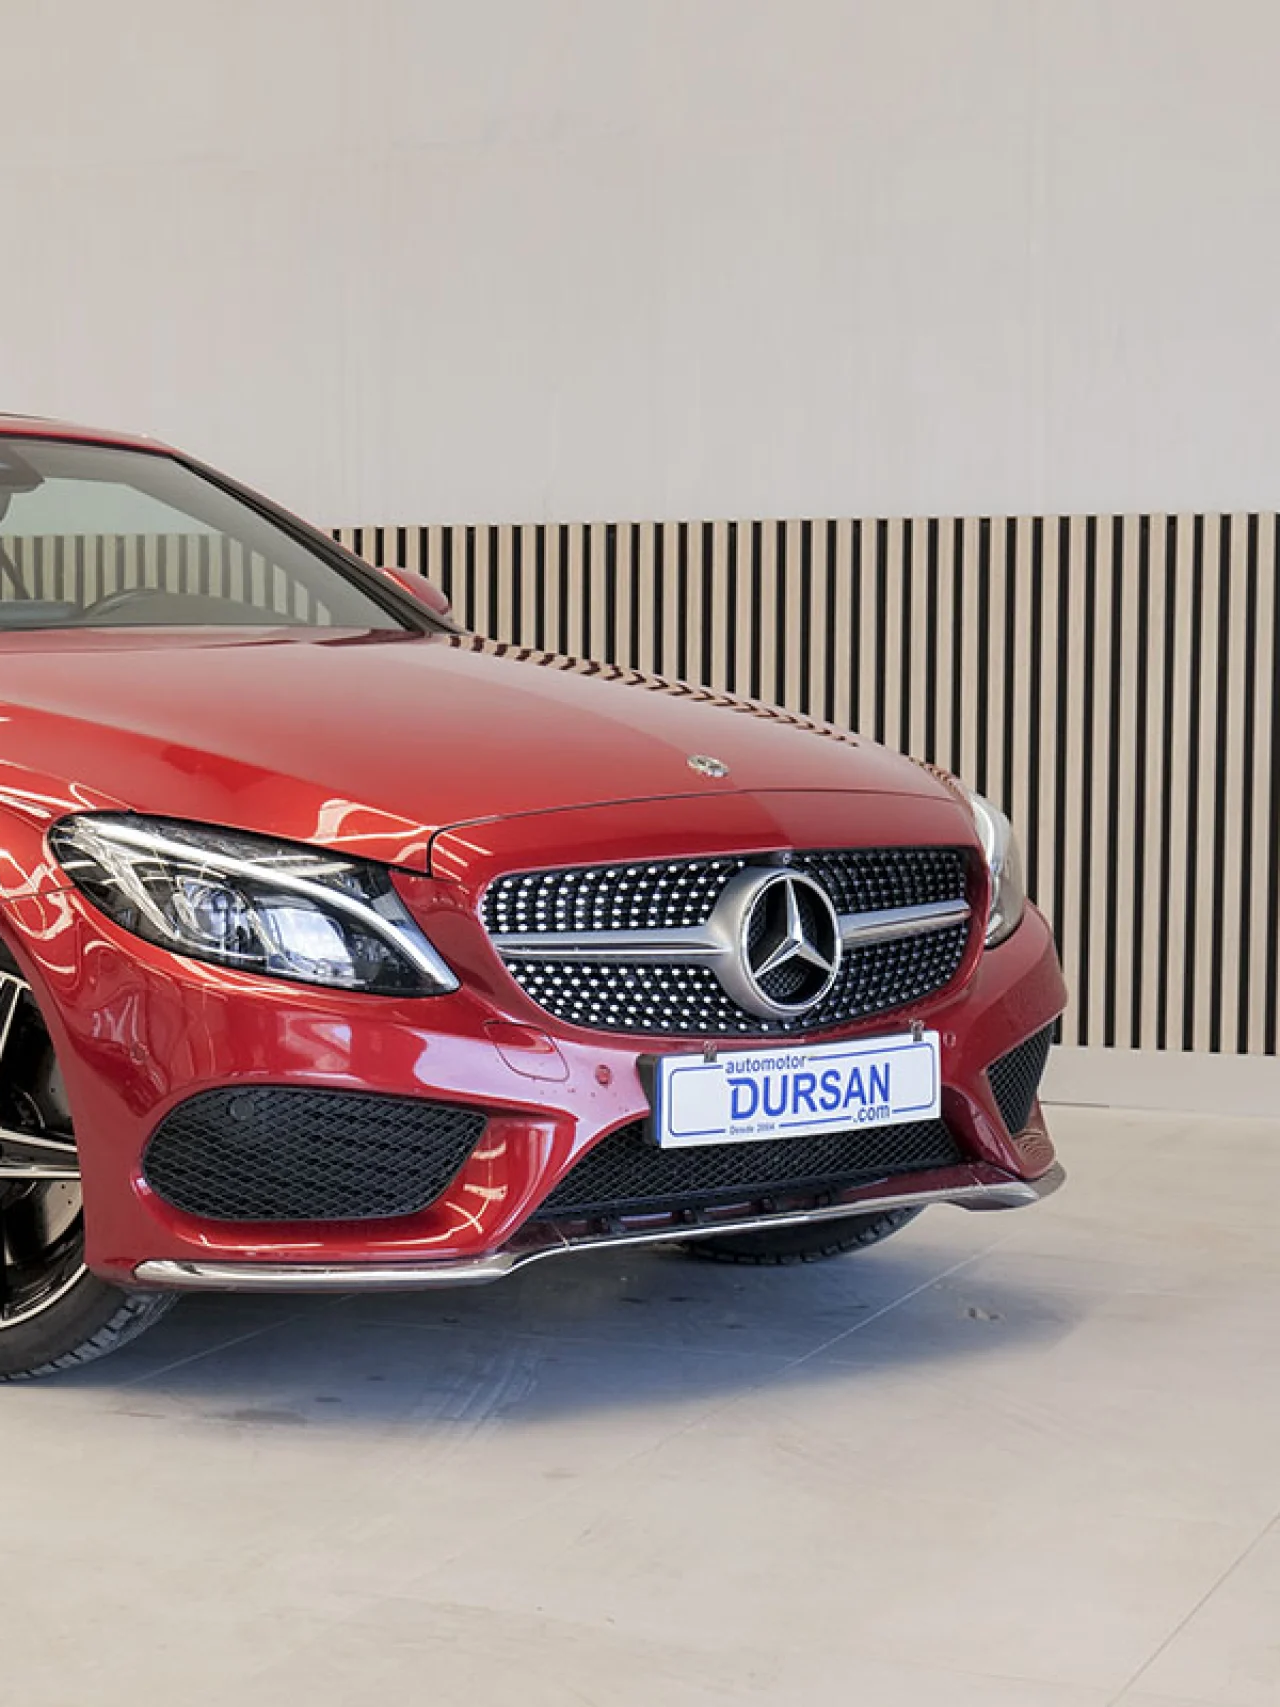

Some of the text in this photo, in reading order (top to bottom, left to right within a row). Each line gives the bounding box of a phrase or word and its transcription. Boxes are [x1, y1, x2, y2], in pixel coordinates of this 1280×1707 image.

[725, 1055, 807, 1074] automotor
[726, 1062, 891, 1121] DURSAN
[853, 1104, 891, 1123] .com
